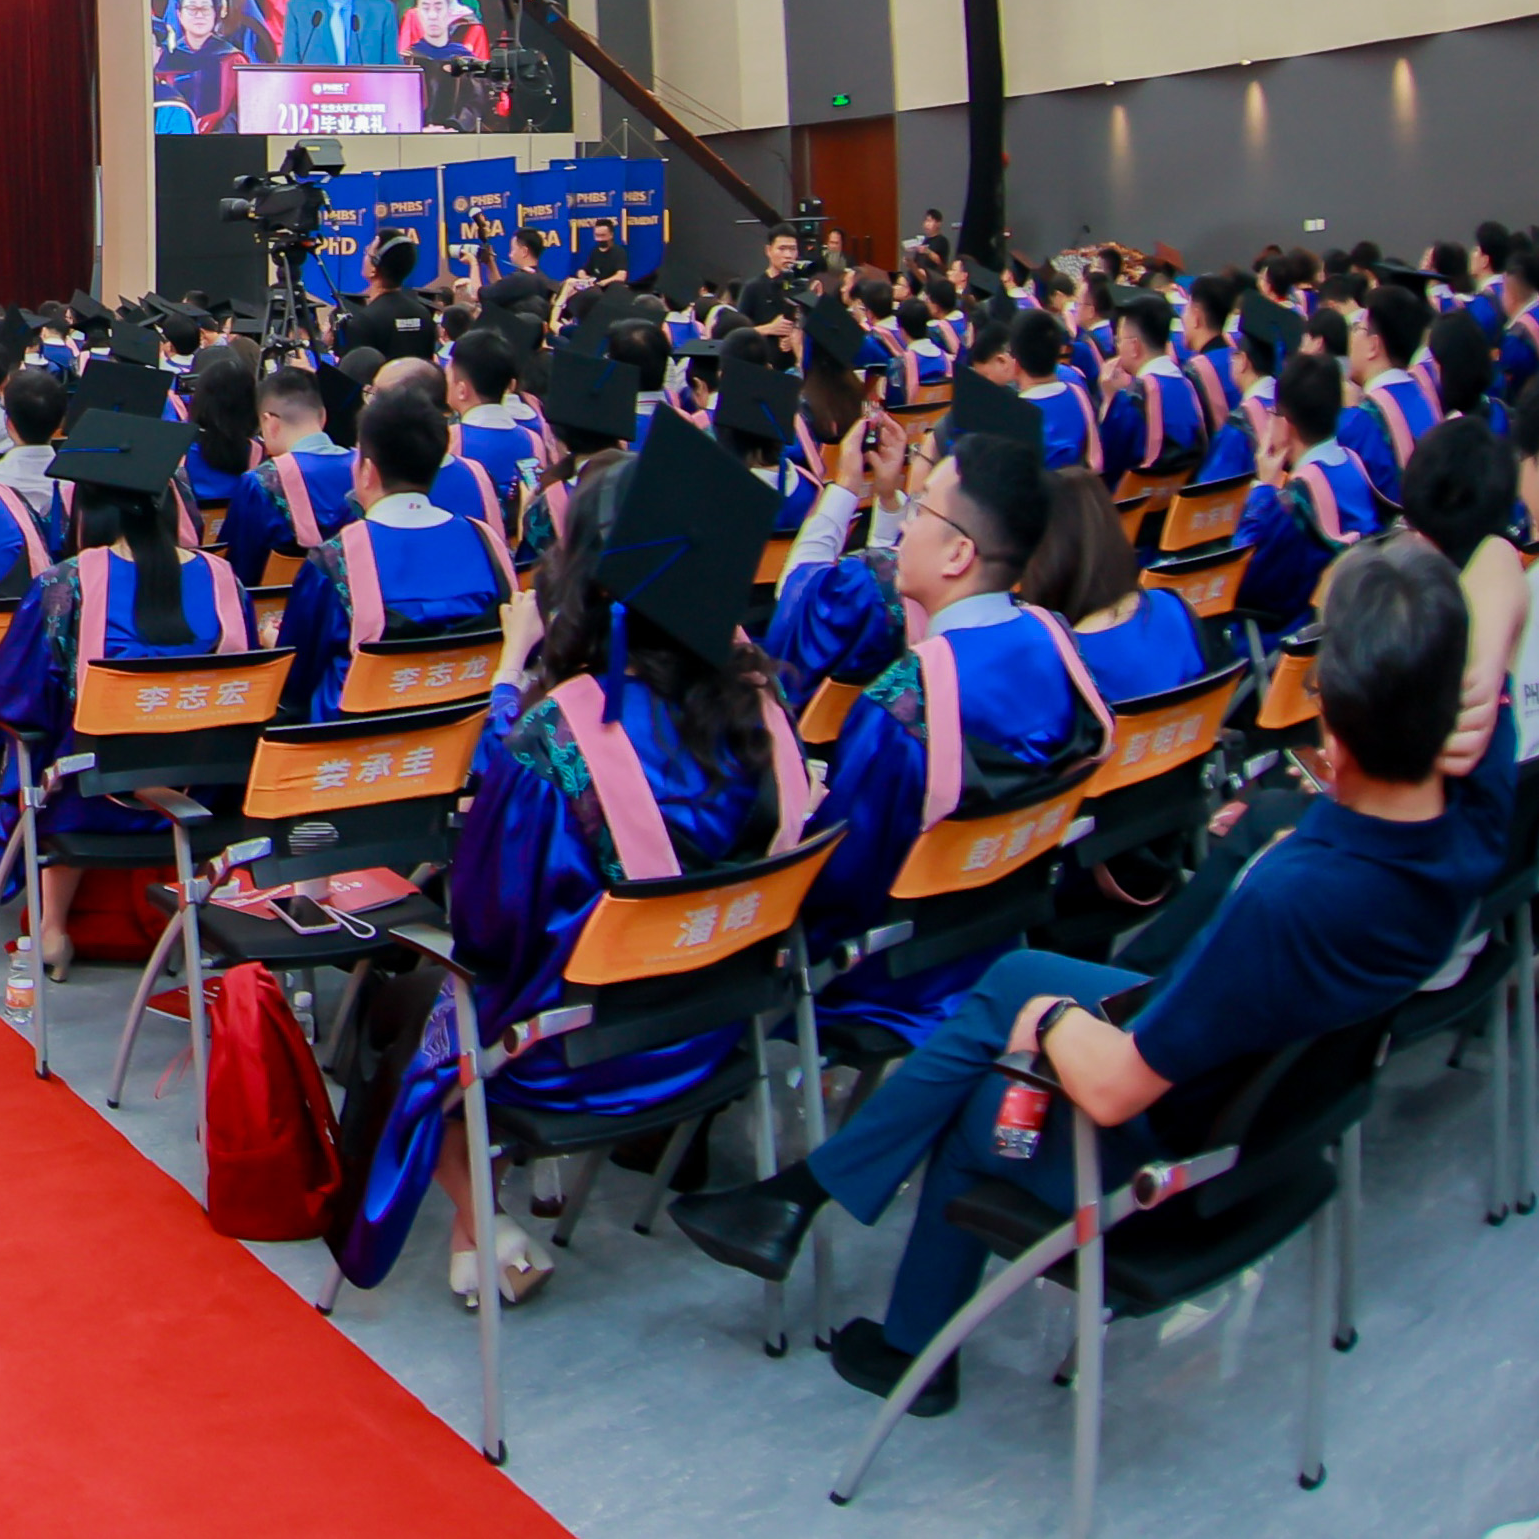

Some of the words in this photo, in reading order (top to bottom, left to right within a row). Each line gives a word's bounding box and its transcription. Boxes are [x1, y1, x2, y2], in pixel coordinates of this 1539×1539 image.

[470, 193, 502, 207] PHBS
[577, 191, 607, 204] PHBS
[390, 200, 423, 213] PHBS
[388, 654, 490, 694] 李志龙
[134, 680, 250, 713] 李志宏
